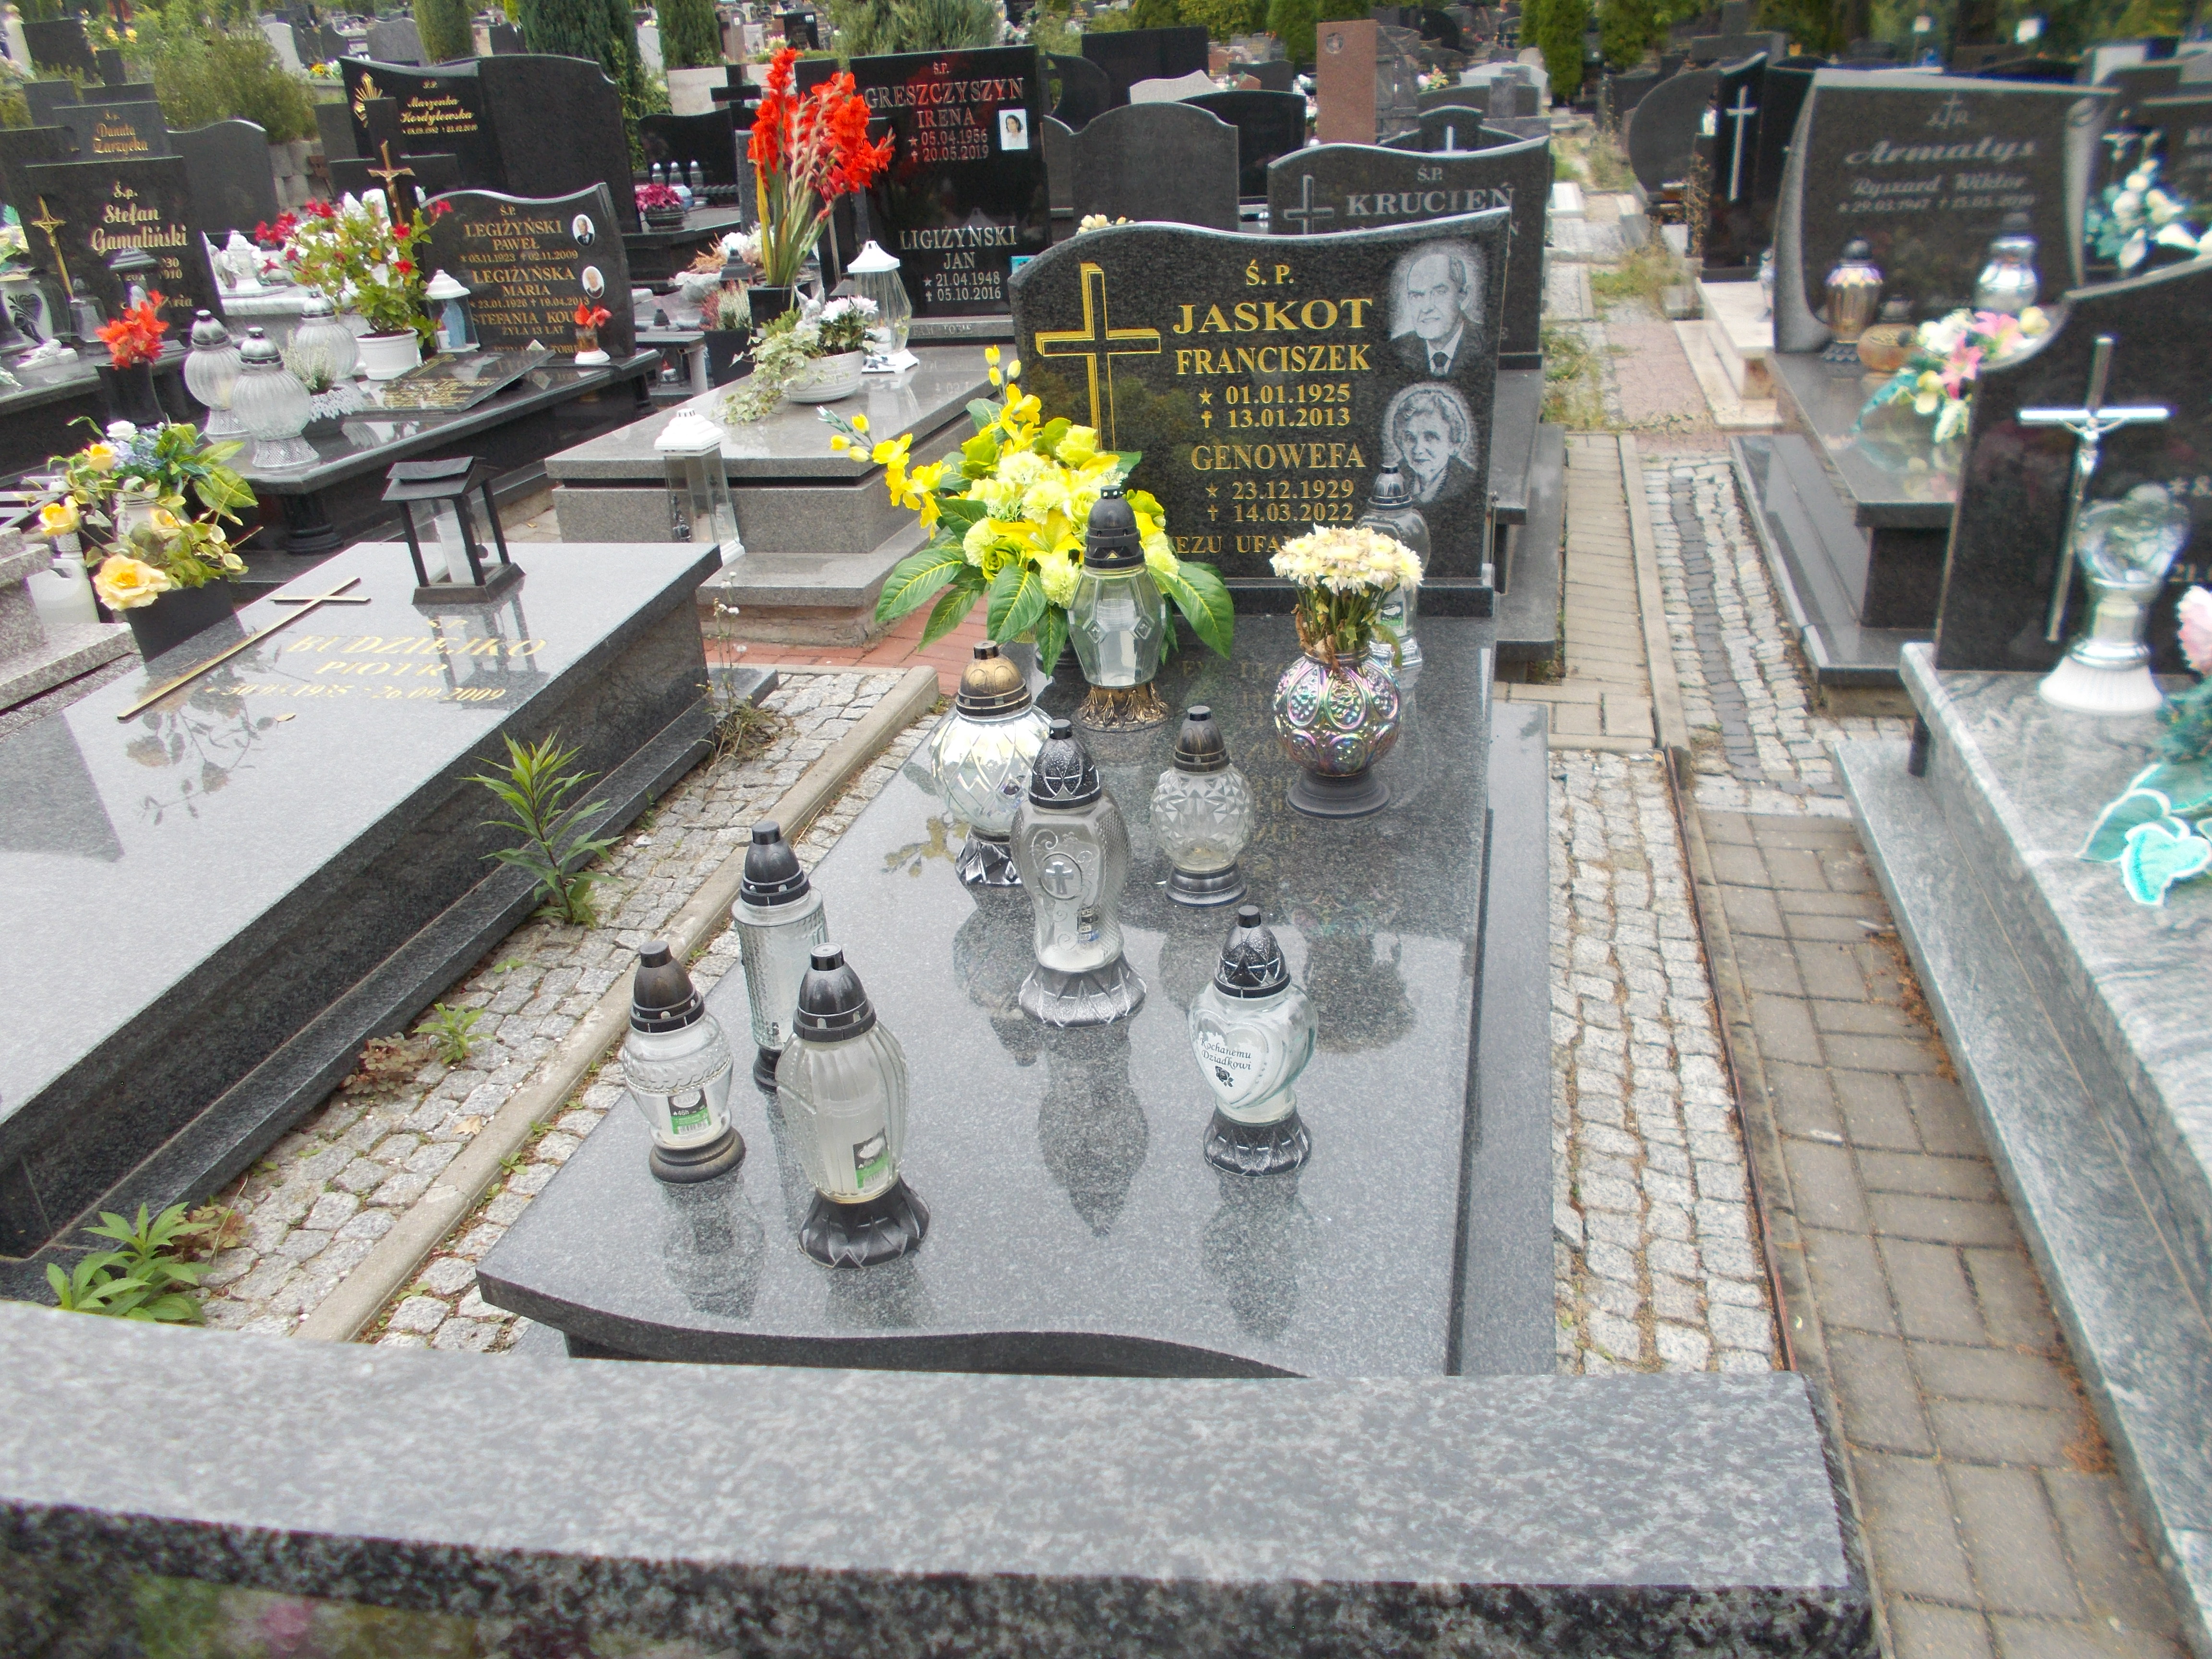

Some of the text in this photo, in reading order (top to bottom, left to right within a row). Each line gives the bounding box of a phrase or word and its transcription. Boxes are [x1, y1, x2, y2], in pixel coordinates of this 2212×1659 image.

[865, 77, 1024, 109] GRESZCZYSZYN
[916, 107, 975, 128] IRENA
[921, 128, 988, 145] 05.04.1956
[1346, 181, 1515, 216] KRUCIEŃ
[103, 203, 161, 226] Stefan
[464, 217, 564, 238] LEGIŻYŃSKI
[899, 224, 1017, 250] LIGIŻYŃSKI
[493, 237, 541, 251] PAWEŁ
[943, 252, 975, 269] JAN
[472, 265, 576, 284] LEGIŻYŃSKA
[936, 271, 1000, 287] 21.04.1948
[502, 284, 551, 297] MARIA
[938, 287, 1001, 301] 05.10.2016
[471, 312, 539, 325] STEFANIA
[1173, 297, 1373, 335] JASKOT
[545, 325, 565, 335] LAT
[1175, 344, 1372, 374] FRANCISZEK
[1226, 383, 1351, 405] 01.01.1925
[1228, 407, 1350, 428] 13.01.2013
[1191, 442, 1366, 470] GENOWEFA
[1232, 479, 1354, 500] 23.12.1929
[1234, 502, 1354, 522] 14.03.2022
[1172, 534, 1292, 554] EZU UFA
[314, 661, 448, 677] PIOTR
[1200, 1038, 1251, 1058] Kochanemu
[1202, 1050, 1251, 1070] Dziadkowi
